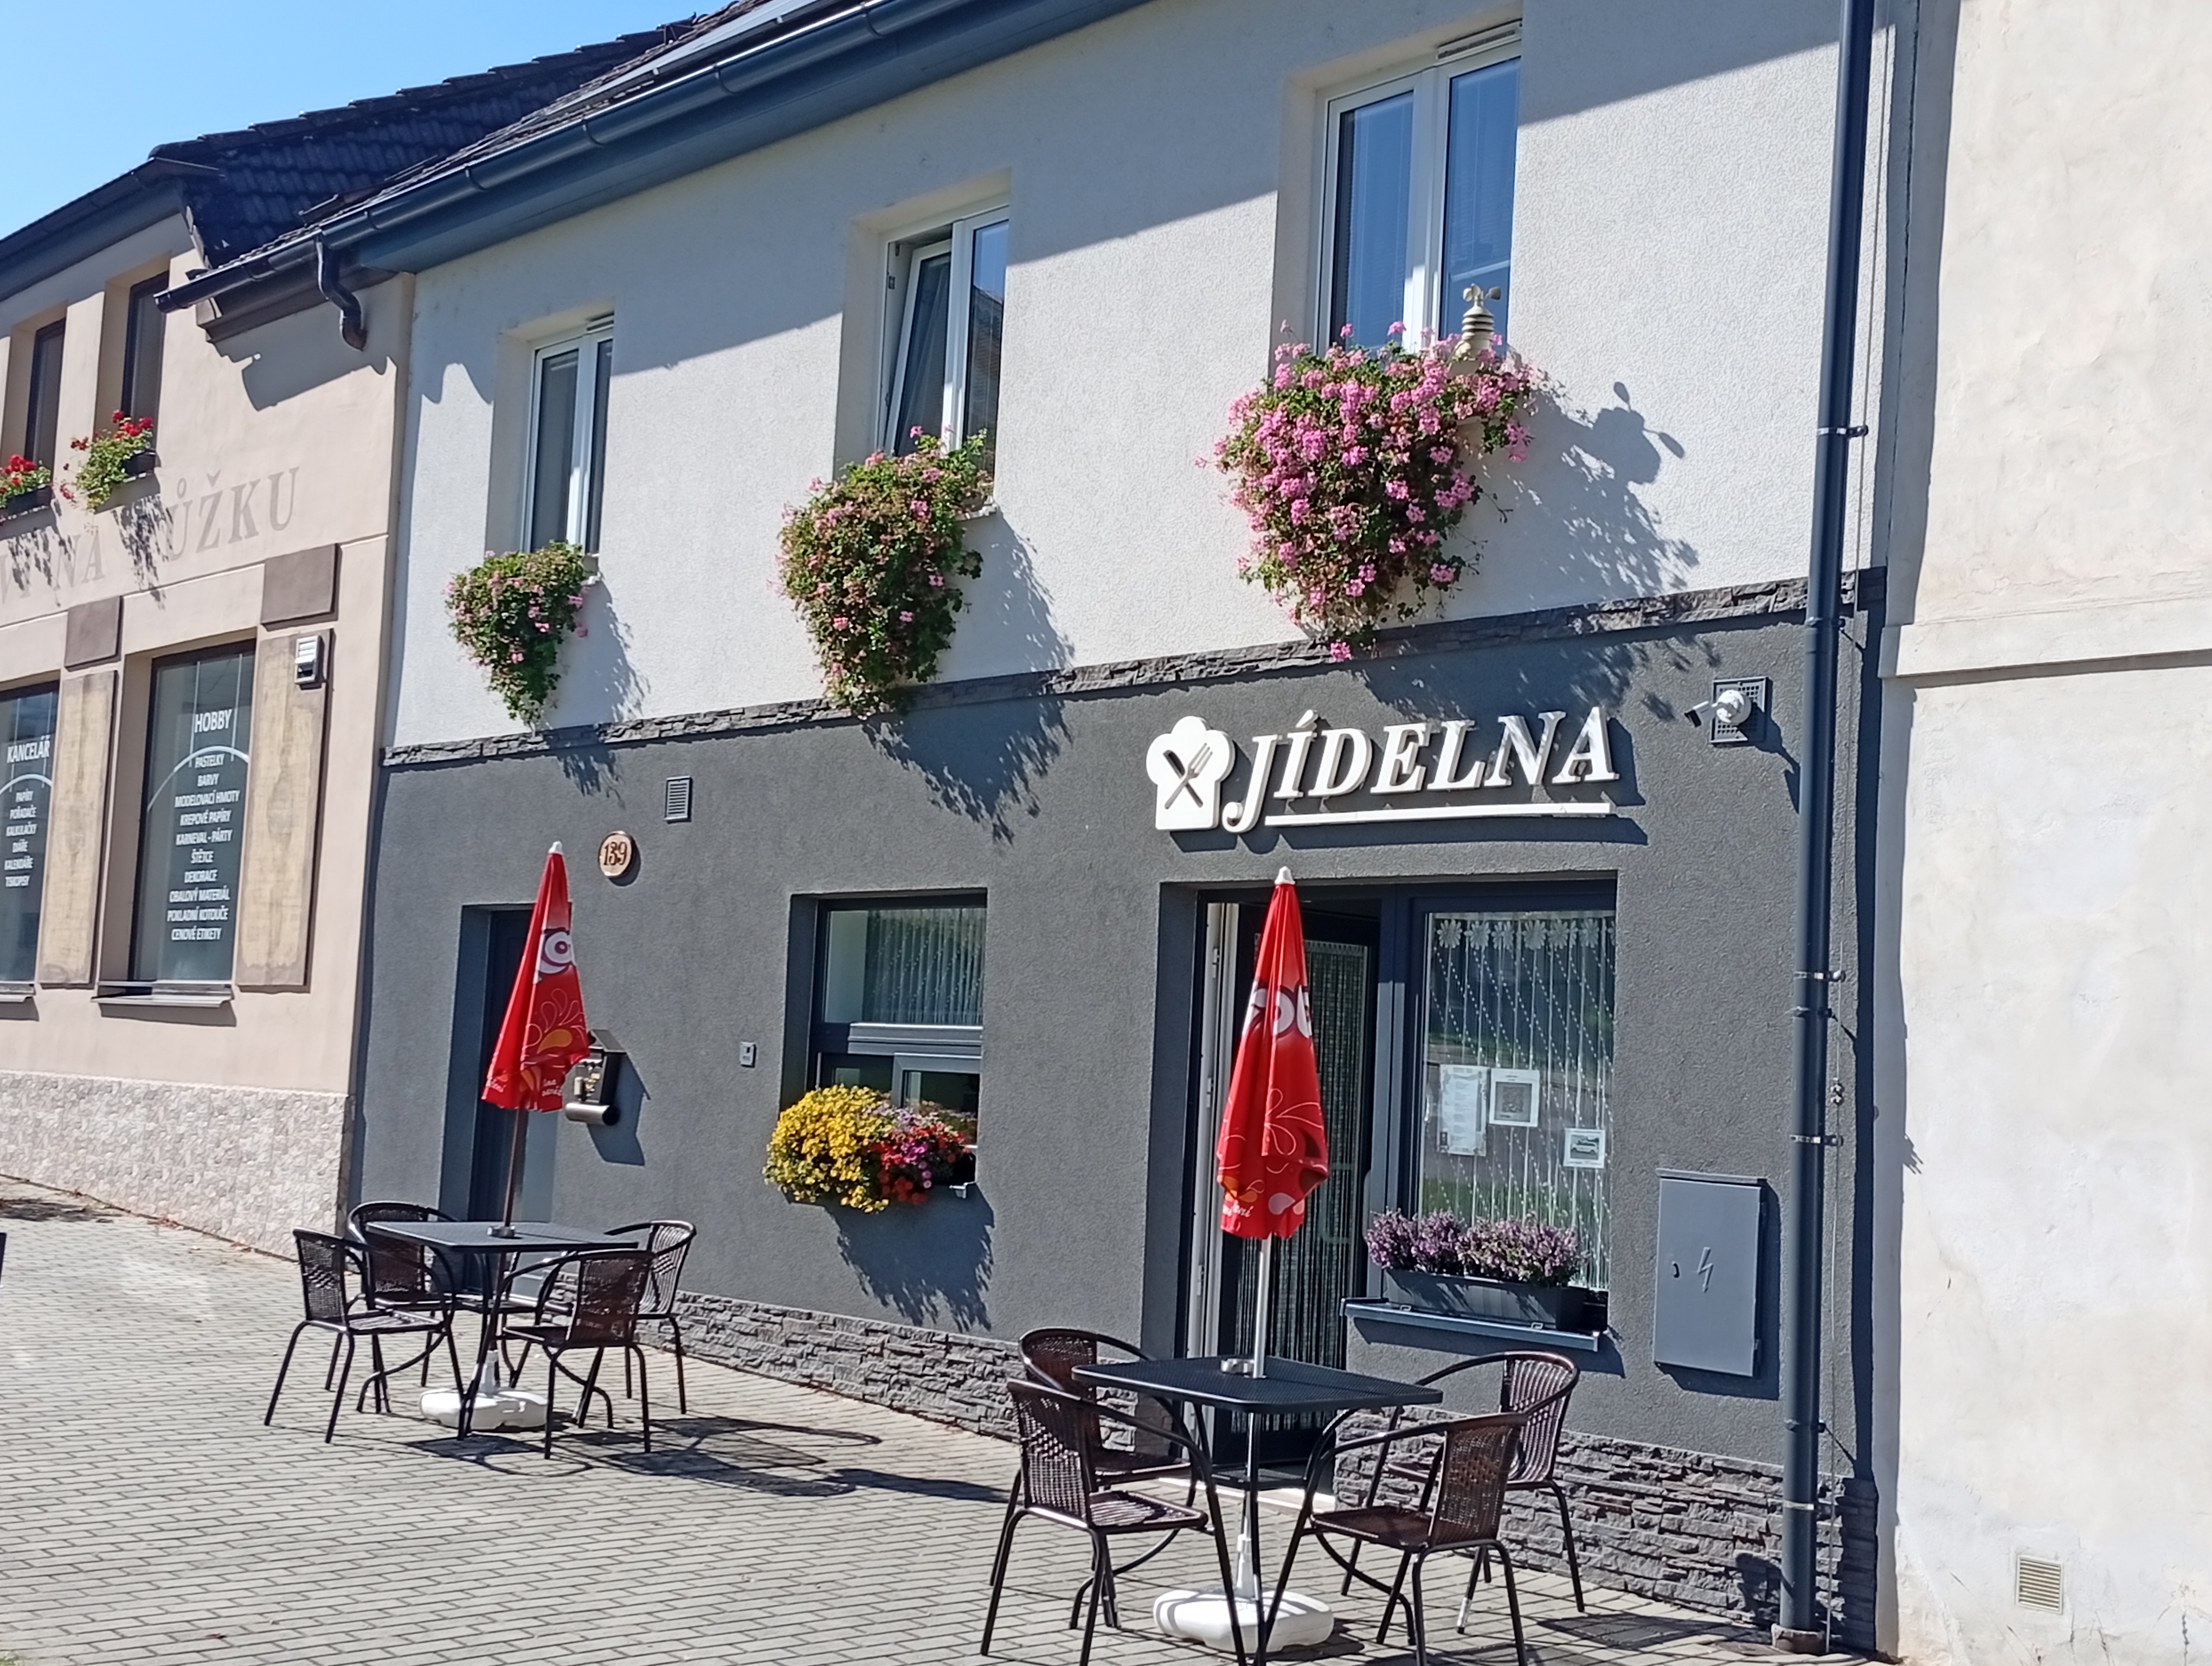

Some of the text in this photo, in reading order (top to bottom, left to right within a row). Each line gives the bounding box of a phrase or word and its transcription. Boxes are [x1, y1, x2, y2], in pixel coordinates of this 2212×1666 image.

[129, 467, 300, 574] ŮŽKU
[194, 709, 233, 733] HOBBY
[7, 735, 50, 763] KANCELÁŘ
[195, 754, 225, 768] PASTELKY
[1221, 706, 1619, 834] JÍDELNA
[197, 773, 219, 787] BARVY
[175, 789, 240, 808] MODELOVACÍ HMOTY
[180, 808, 232, 826] KREPOVÉ PAPÍRY
[176, 832, 207, 845] KARNEVAL
[211, 828, 233, 842] PÁRTY
[603, 841, 627, 866] 139
[184, 869, 218, 883] DEKORACE
[169, 885, 230, 902] OBALOVÝ MATERIÁL
[167, 906, 199, 921] POKLADNÍ
